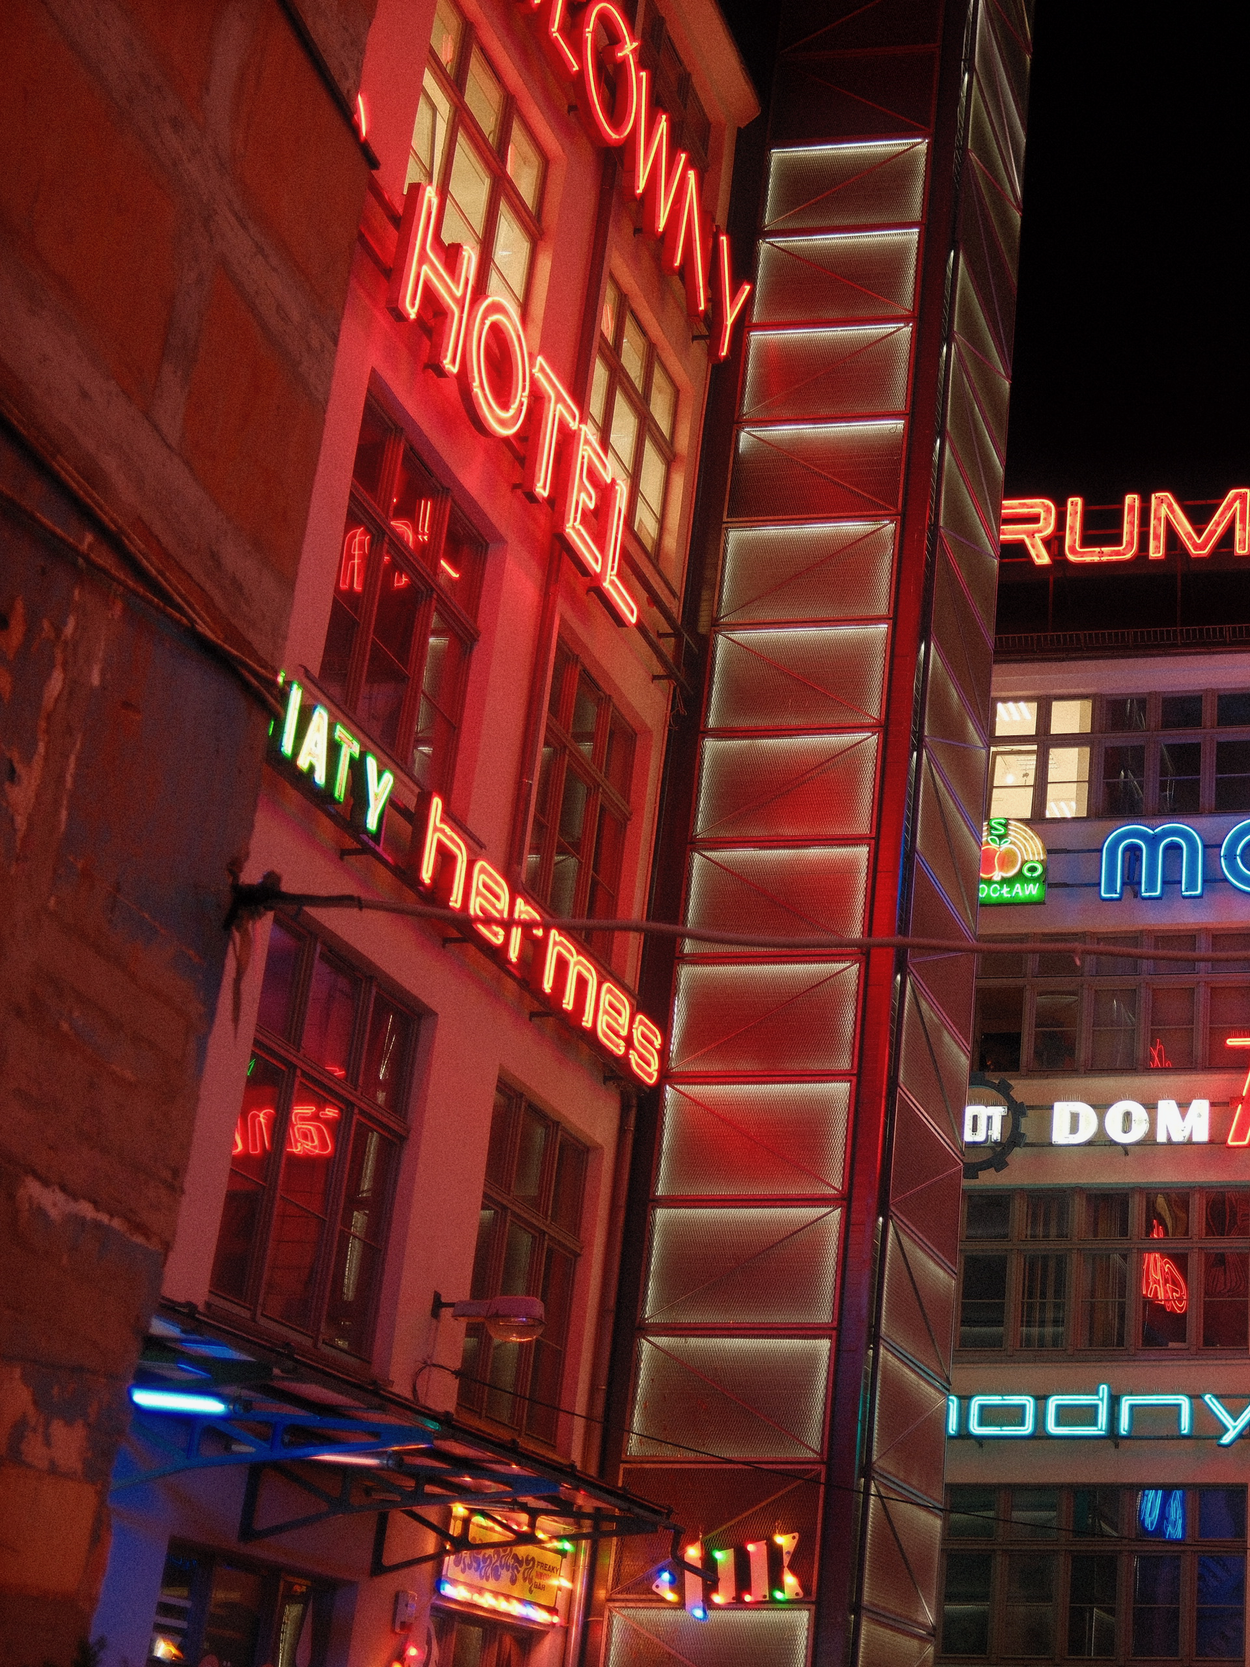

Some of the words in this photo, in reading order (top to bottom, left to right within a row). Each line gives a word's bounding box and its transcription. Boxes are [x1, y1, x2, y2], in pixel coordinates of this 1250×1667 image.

[530, 0, 751, 358] ÓWNY
[402, 183, 638, 625] HOTEL
[269, 669, 394, 834] IATY
[420, 795, 664, 1087] hermes
[979, 882, 1040, 898] OCŁAW
[963, 1104, 1009, 1143] OT
[1050, 1098, 1211, 1146] DOM
